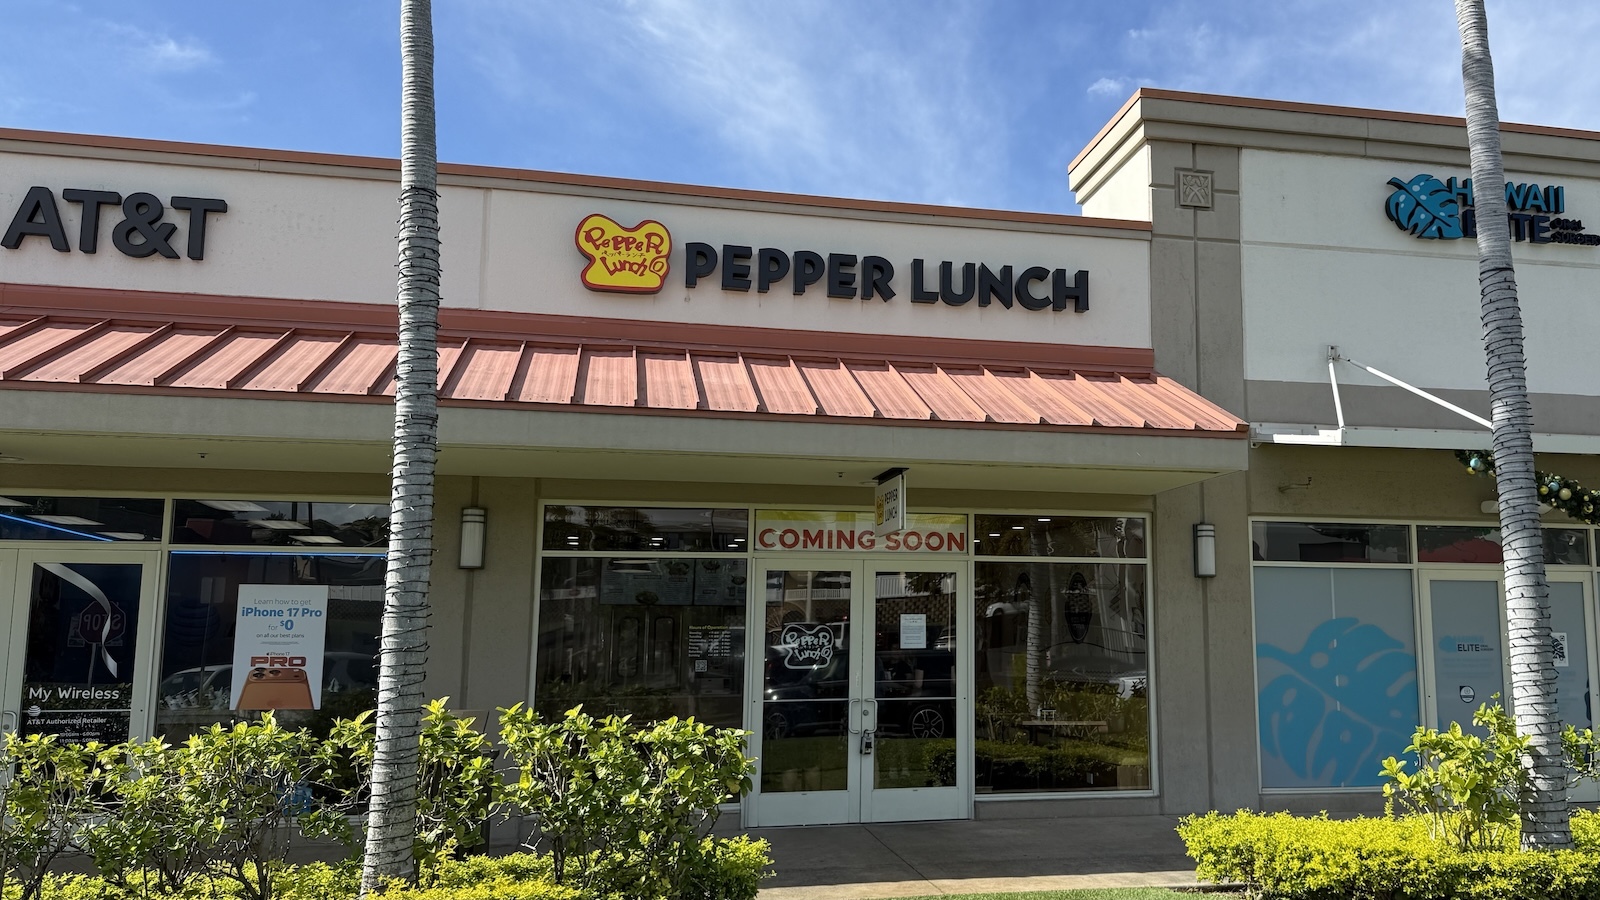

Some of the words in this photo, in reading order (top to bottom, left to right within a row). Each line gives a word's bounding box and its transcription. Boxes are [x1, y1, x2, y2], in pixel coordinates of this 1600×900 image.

[1447, 176, 1565, 214] HWAII
[0, 186, 228, 260] AT&T
[1462, 209, 1551, 244] ETE
[1551, 231, 1600, 246] SURGER
[685, 242, 897, 302] PEPPER
[910, 258, 1090, 313] LUNCH
[884, 488, 898, 505] PEPPER
[884, 505, 898, 522] LUNCH
[758, 528, 876, 550] COMING
[885, 530, 965, 551] SOON
[300, 599, 311, 607] get
[242, 607, 284, 617] iPhone
[287, 607, 299, 617] 17
[301, 607, 322, 617] Pro
[280, 619, 294, 631] $0
[1457, 643, 1480, 652] ELITE
[250, 656, 307, 667] PRO
[28, 687, 52, 702] My
[58, 686, 120, 700] Wireless
[46, 717, 81, 725] Authorized
